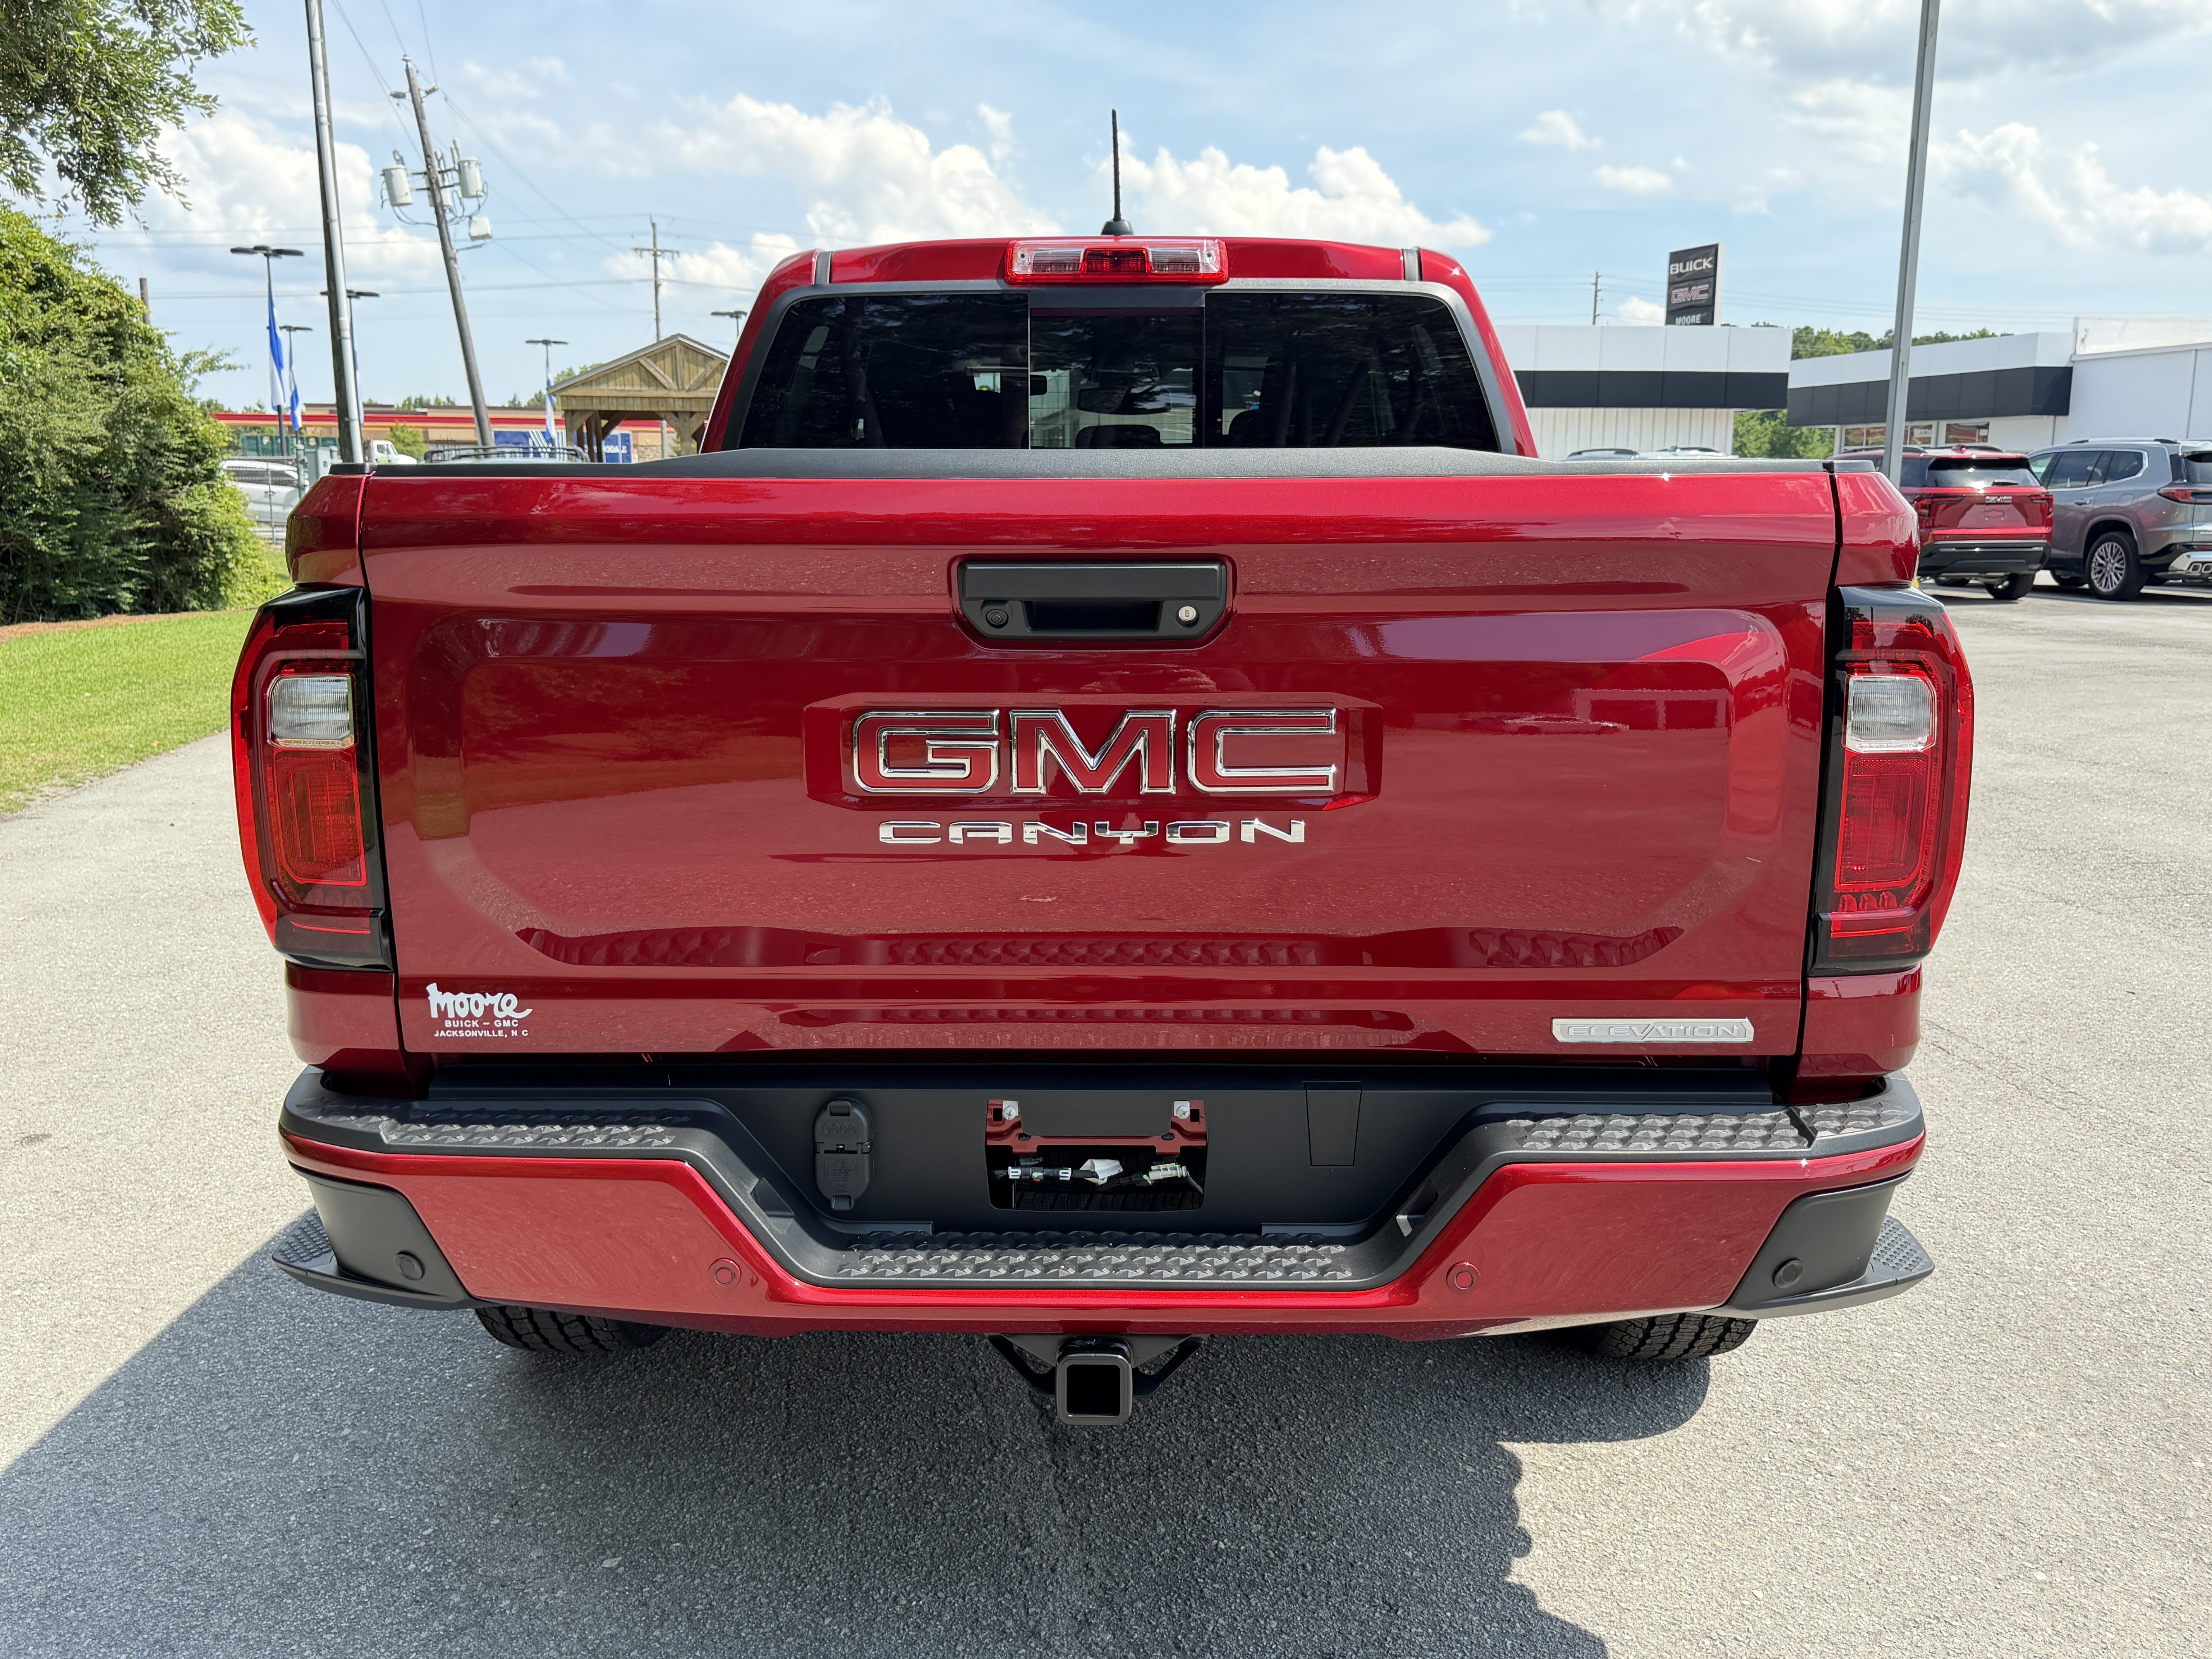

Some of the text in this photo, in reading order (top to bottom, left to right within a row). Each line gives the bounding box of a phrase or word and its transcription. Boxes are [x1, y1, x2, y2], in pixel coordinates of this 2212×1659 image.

[1669, 256, 1714, 275] BUICK
[1671, 283, 1709, 304] GMC
[1675, 313, 1702, 325] MOORE
[853, 709, 1337, 795] GMC
[878, 820, 1305, 845] CANYON
[1568, 1025, 1739, 1037] ELEVATION
